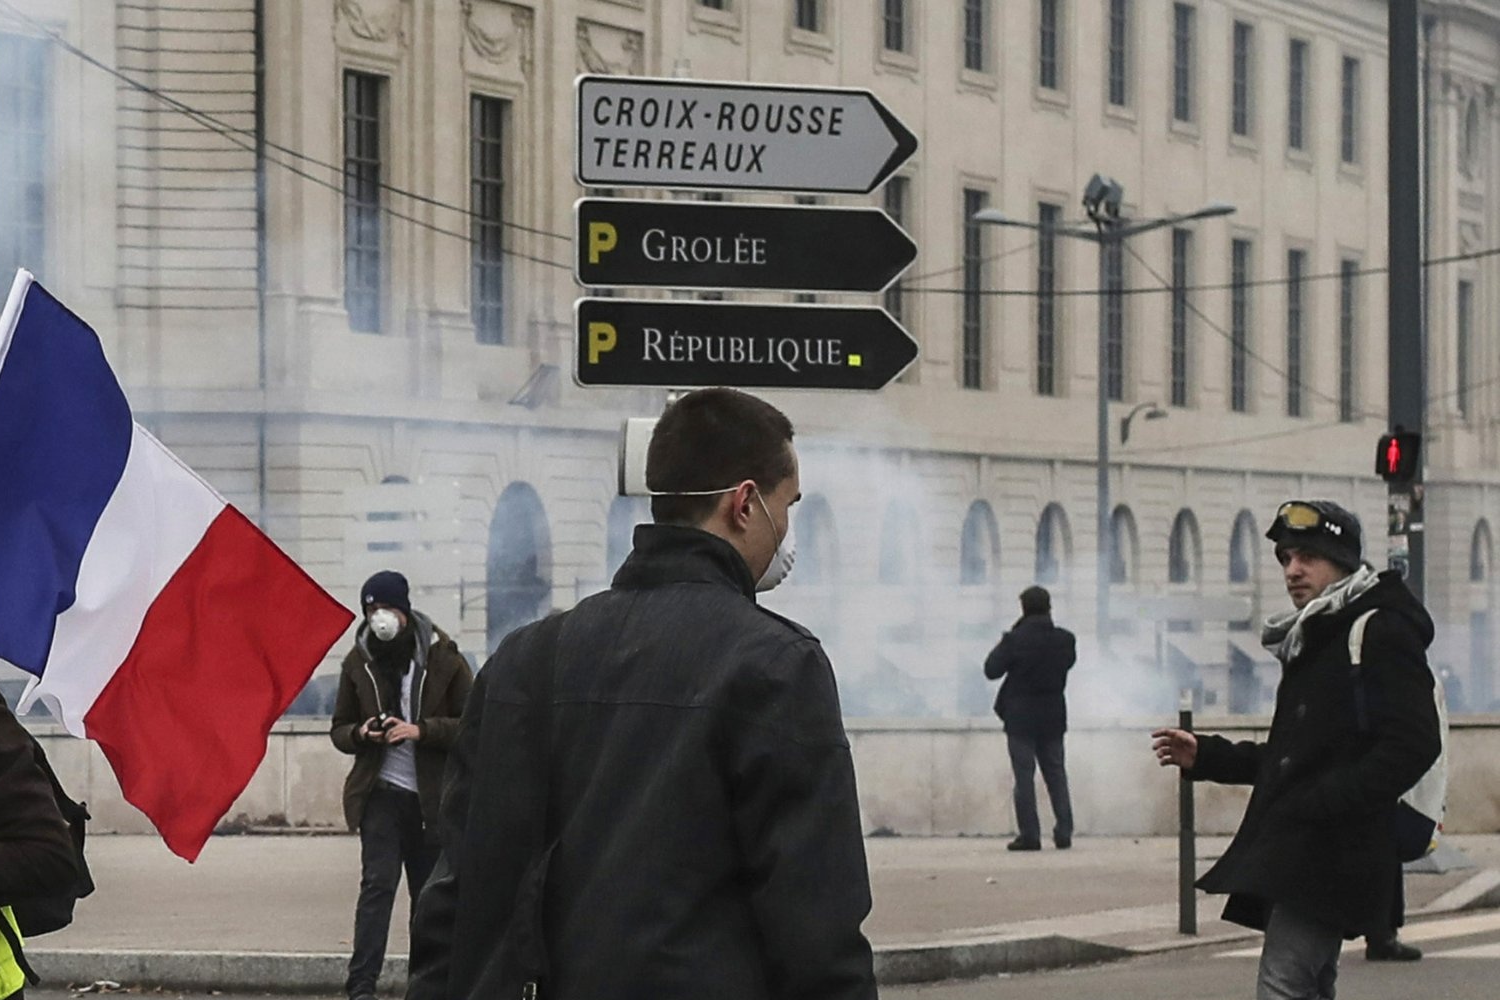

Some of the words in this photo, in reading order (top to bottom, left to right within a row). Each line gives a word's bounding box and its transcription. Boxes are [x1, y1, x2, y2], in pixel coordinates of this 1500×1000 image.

[592, 96, 844, 136] CROIX-ROUSSE
[593, 138, 766, 173] TERREAUX
[589, 222, 617, 263] P
[588, 322, 617, 363] P
